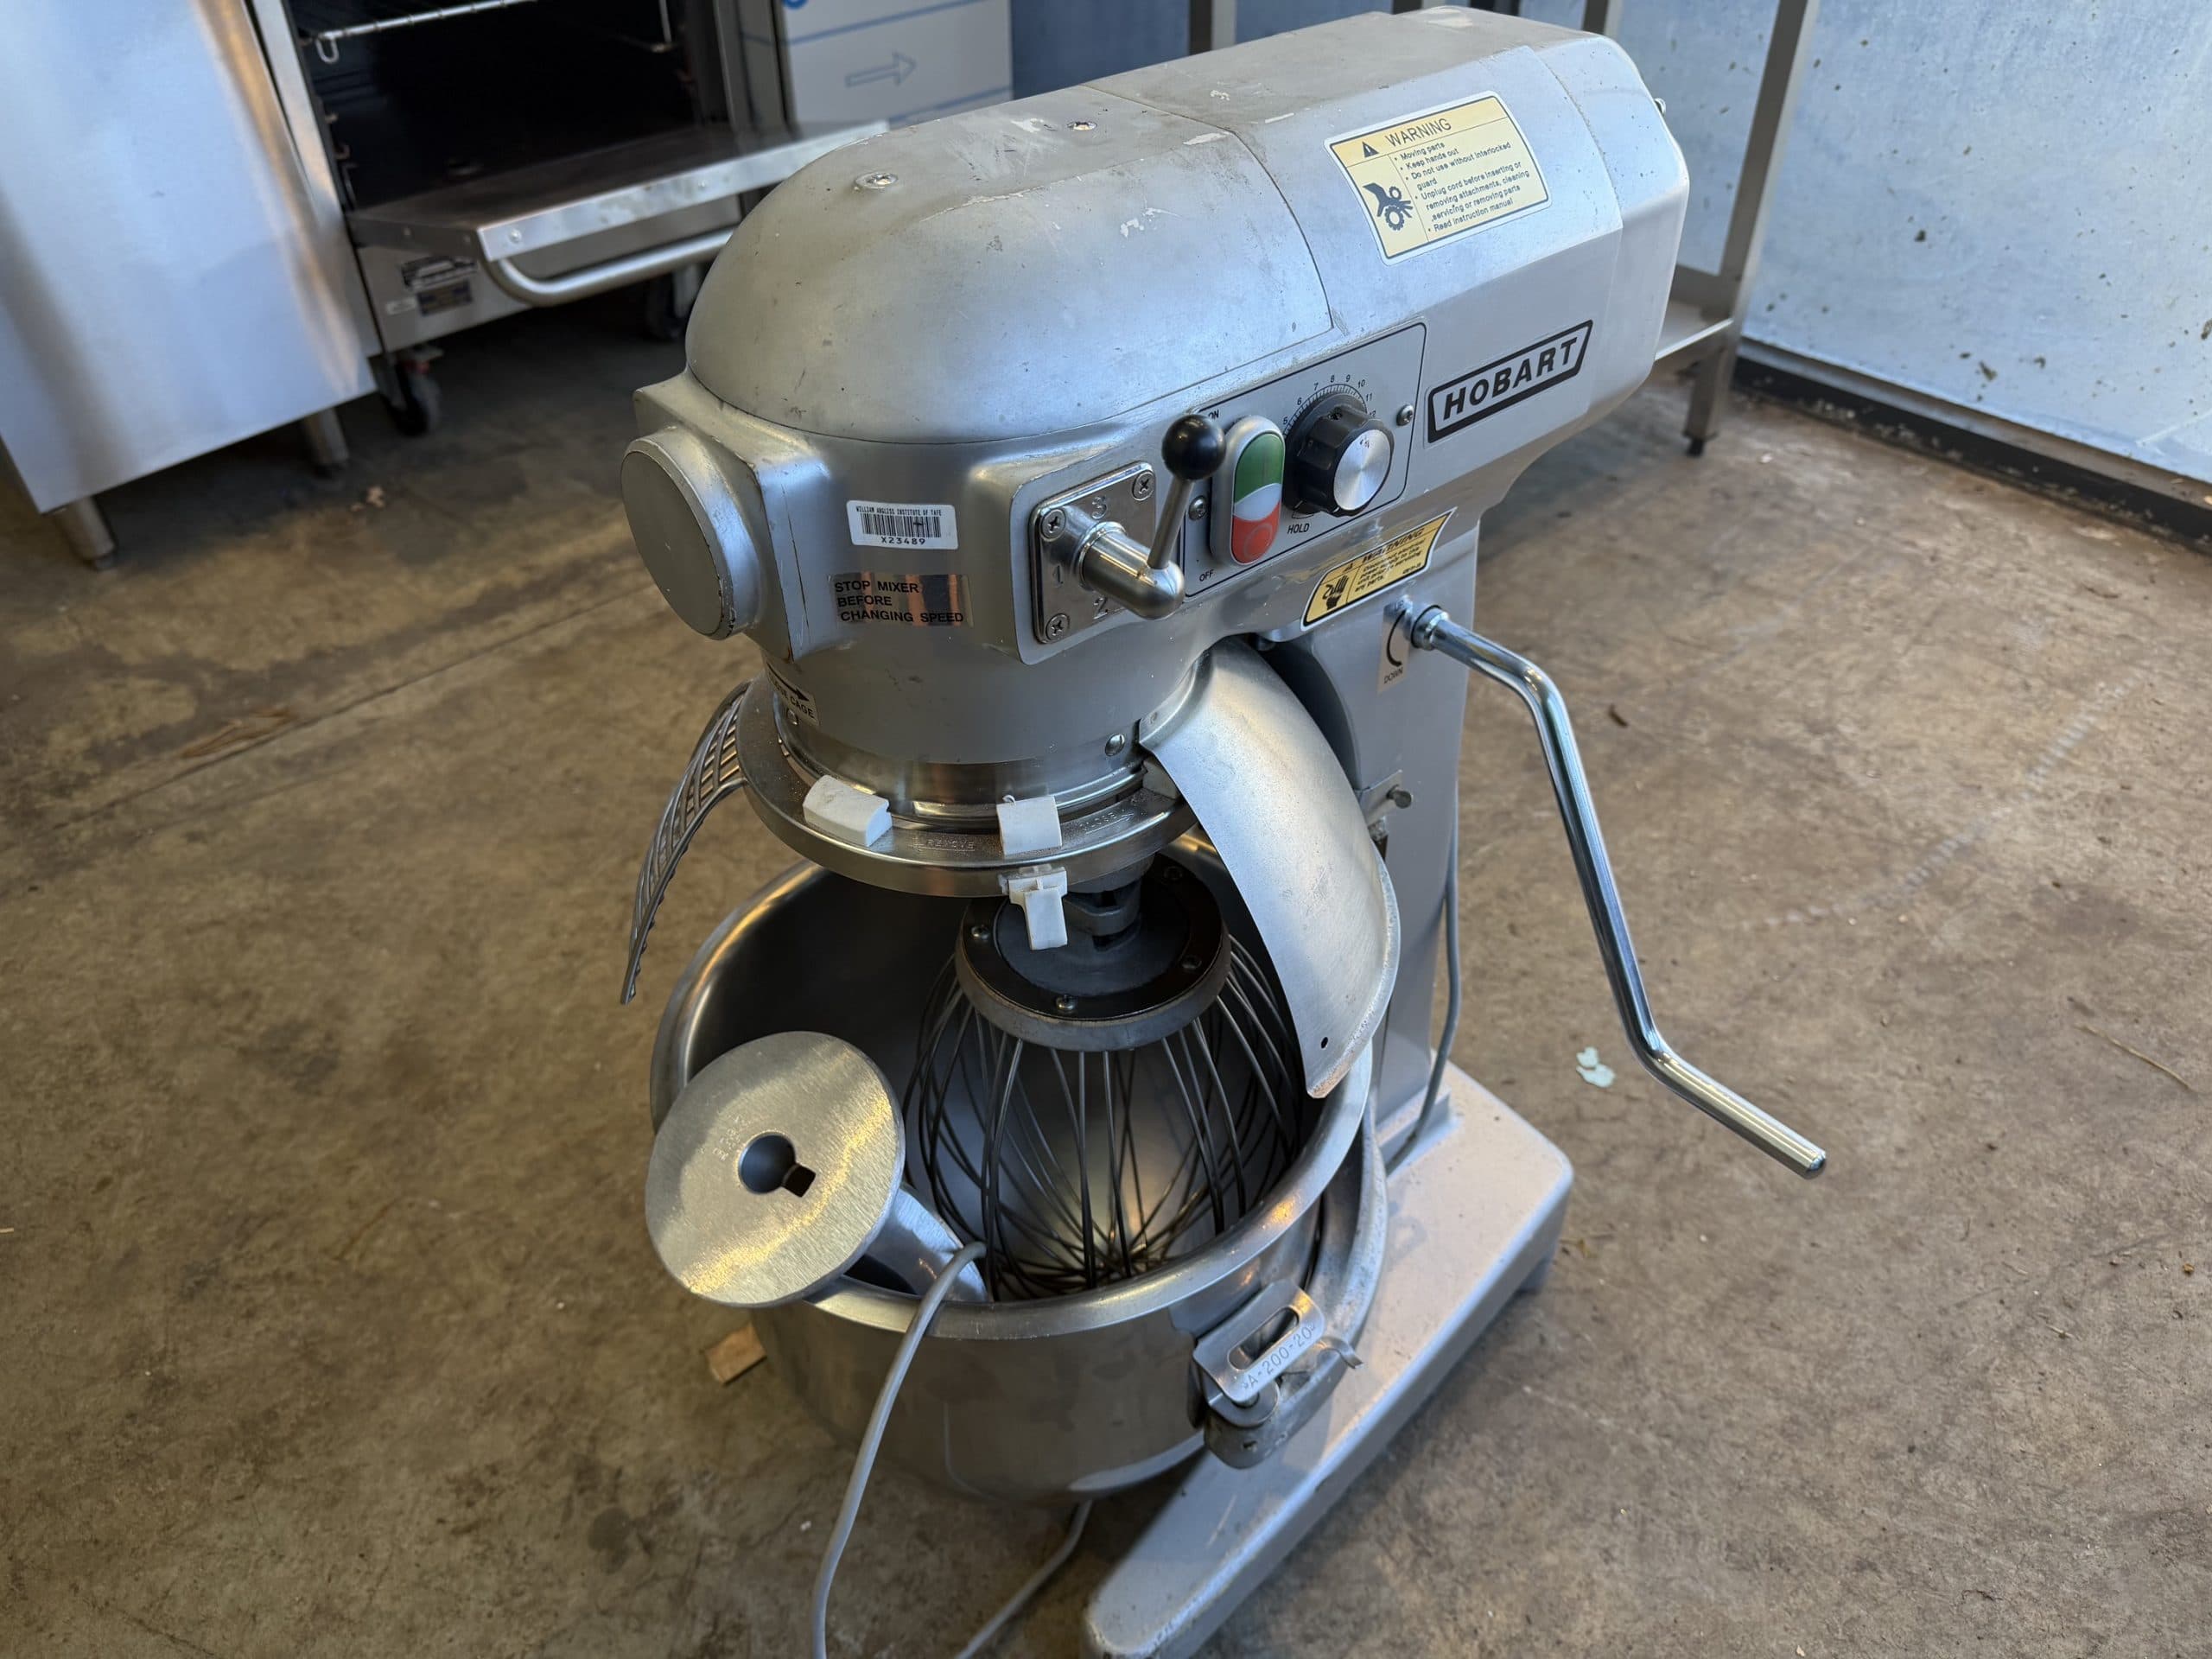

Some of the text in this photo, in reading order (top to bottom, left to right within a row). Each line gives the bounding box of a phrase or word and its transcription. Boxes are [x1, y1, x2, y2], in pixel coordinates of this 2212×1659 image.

[1385, 118, 1452, 147] WARNING
[1400, 143, 1445, 160] Moving parts
[1406, 148, 1459, 169] Keep hands out
[1422, 167, 1435, 175] not
[1435, 162, 1449, 171] use
[1450, 154, 1474, 167] without
[1474, 142, 1511, 157] interlocked
[1417, 178, 1438, 191] guard
[1421, 186, 1447, 200] Unplug
[1447, 181, 1463, 191] cord
[1464, 174, 1485, 186] before
[1485, 164, 1514, 177] inserting
[1426, 169, 1529, 210] removing attachments, cleaning
[1473, 190, 1503, 206] removing
[1503, 185, 1521, 195] parts
[1433, 197, 1513, 232] Read instruction manual
[1313, 382, 1319, 391] 7
[1357, 379, 1365, 388] 10
[1443, 337, 1578, 421] HOBART
[1366, 392, 1373, 401] 11
[1283, 416, 1288, 425] 5
[1091, 496, 1108, 519] 3
[1287, 523, 1310, 534] HOLD
[881, 536, 925, 545] X23489
[1053, 564, 1064, 588] 1
[1199, 569, 1214, 582] OFF
[835, 580, 919, 594] STOP MIXER
[837, 594, 893, 607] BEFORE
[1093, 596, 1109, 620] 2
[840, 610, 964, 623] CHANGING SPEED
[1383, 666, 1403, 684] DOWN
[790, 696, 815, 719] CAGE
